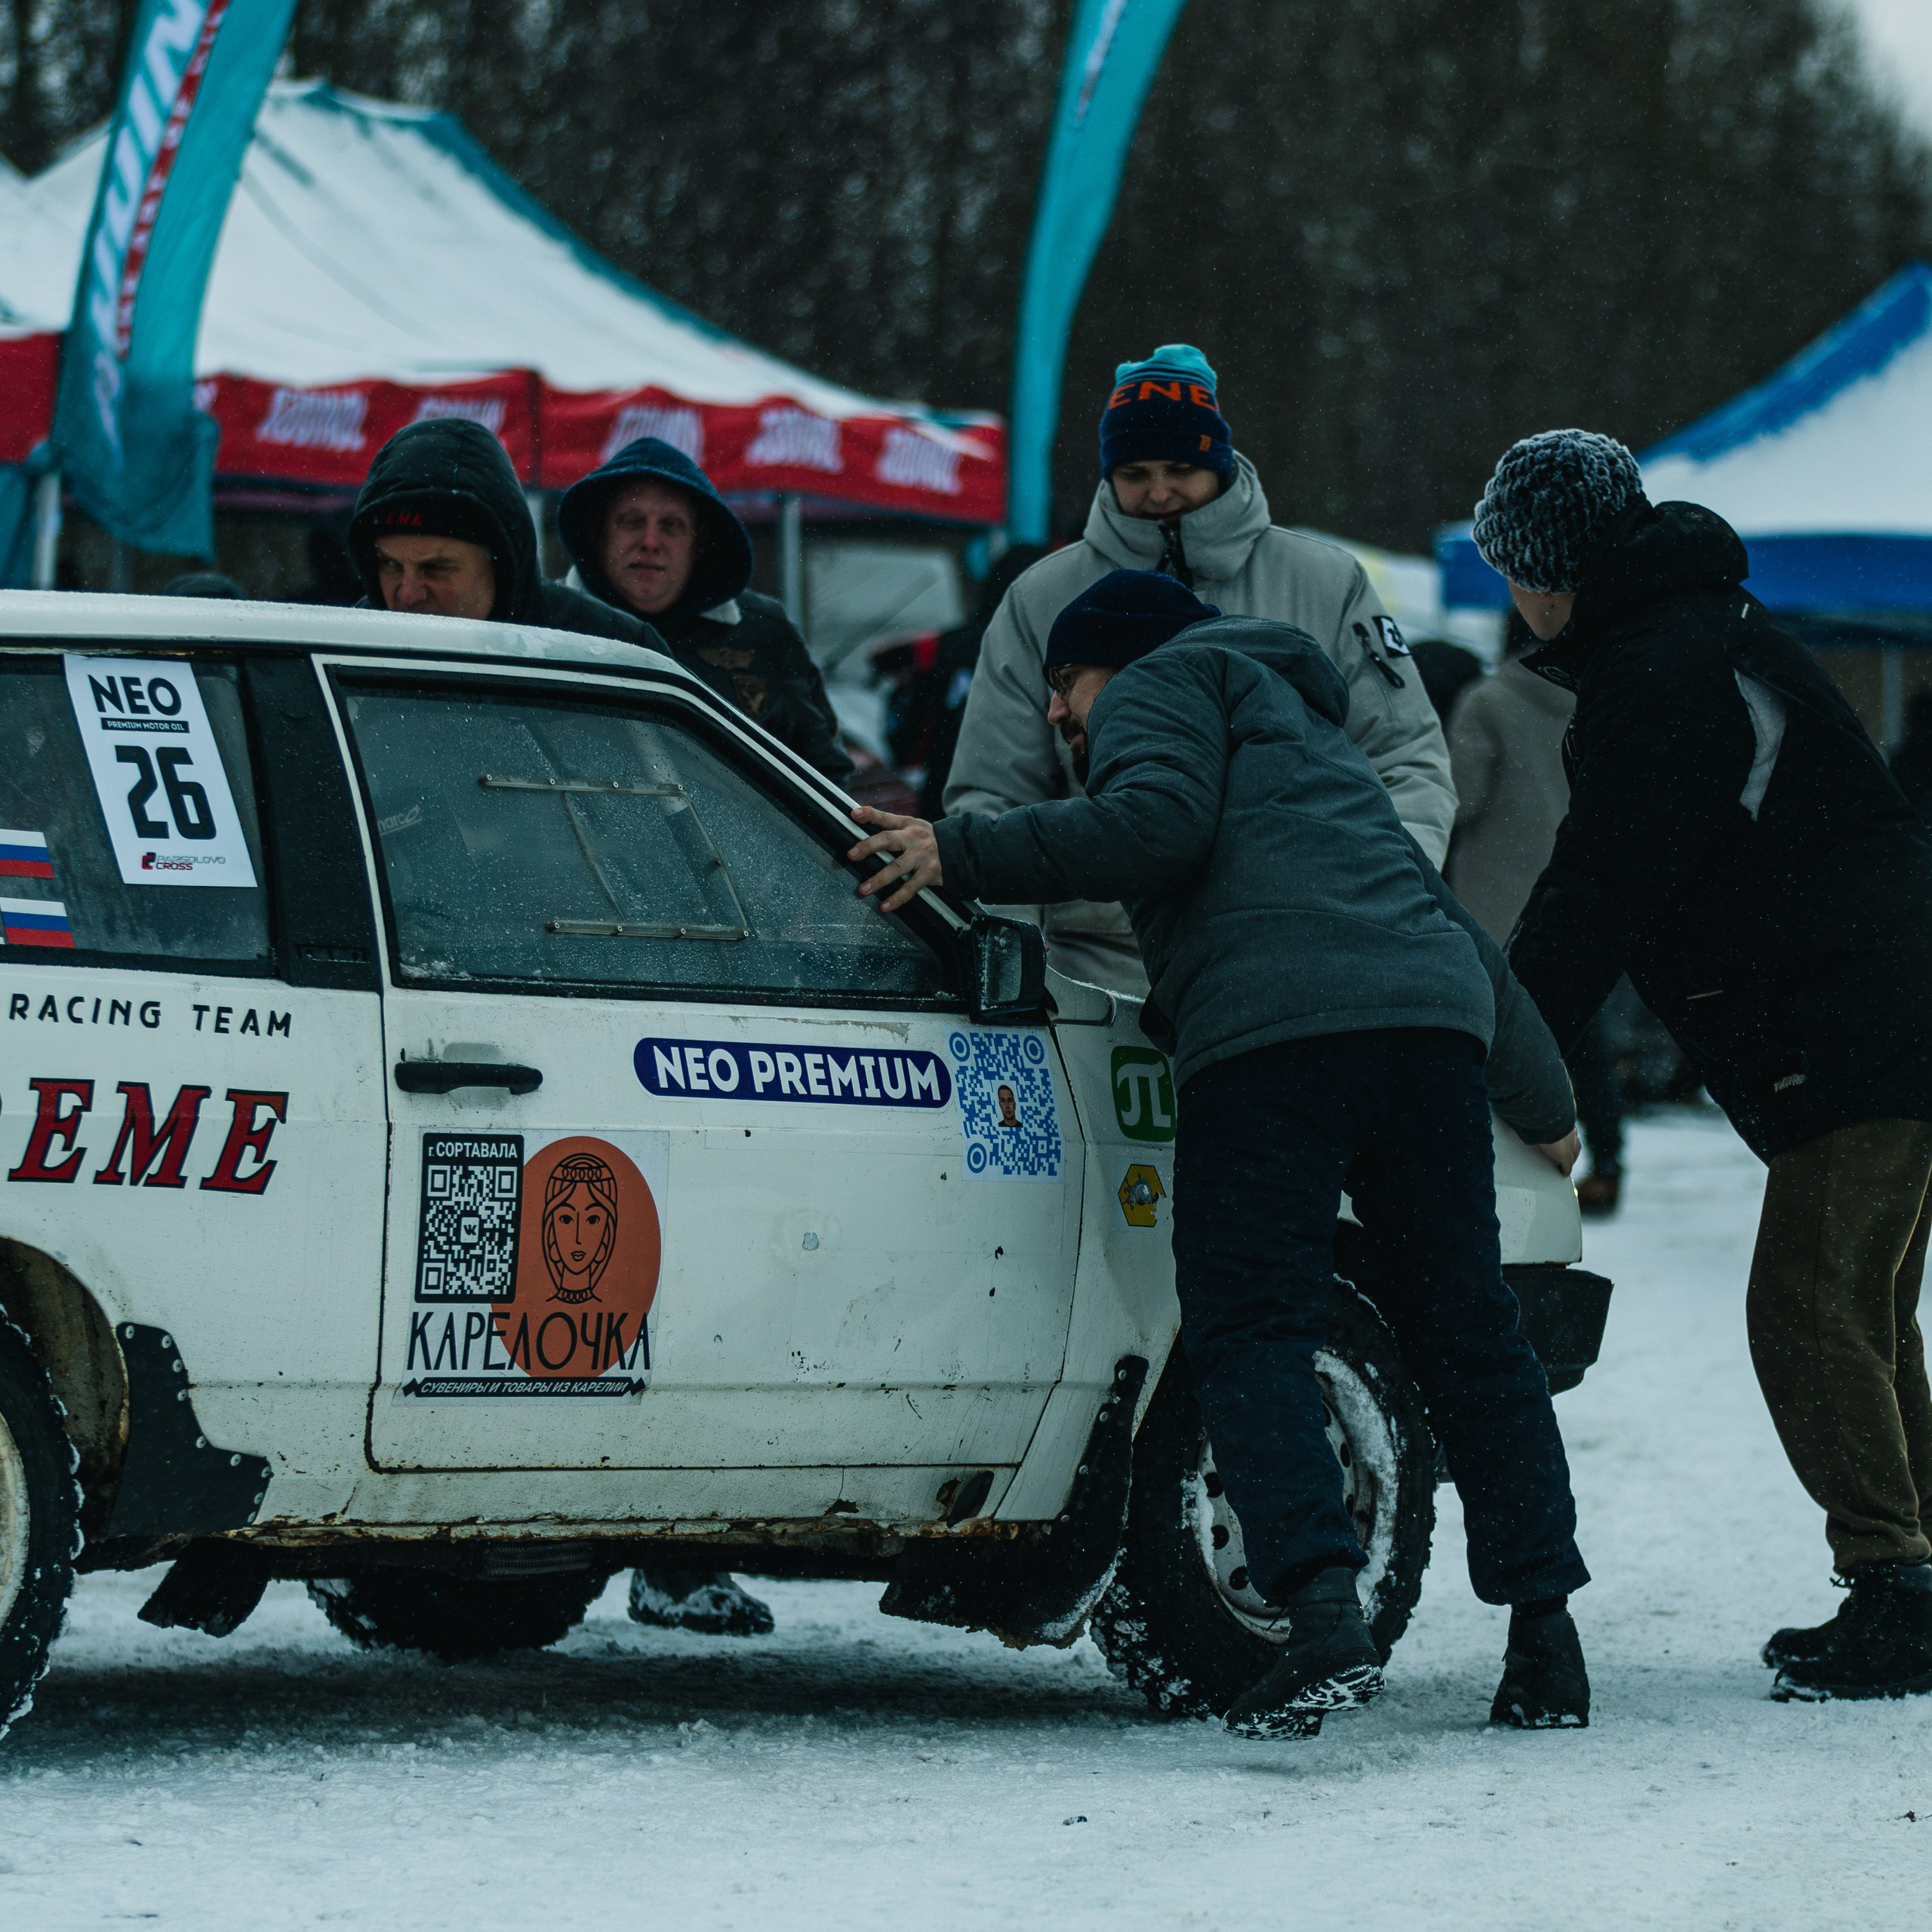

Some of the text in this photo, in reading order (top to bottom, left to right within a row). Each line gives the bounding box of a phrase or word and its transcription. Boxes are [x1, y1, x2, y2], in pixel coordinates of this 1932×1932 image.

[377, 512, 423, 526] EME
[88, 674, 182, 716] NEO
[107, 721, 142, 729] PREMIUM
[115, 744, 217, 840] 26
[155, 862, 193, 870] CROSS
[9, 993, 292, 1038] RACING TEAM
[654, 1045, 941, 1100] NEO PREMIUM
[0, 1077, 290, 1195] EME
[436, 1142, 518, 1158] СОРТАВАЛА
[407, 1312, 651, 1371] КАРЕЛОЧКА
[421, 1382, 629, 1393] СУВЕНИРЫ И ТОВАРЫ ИЗ КАРЕЛИИ
